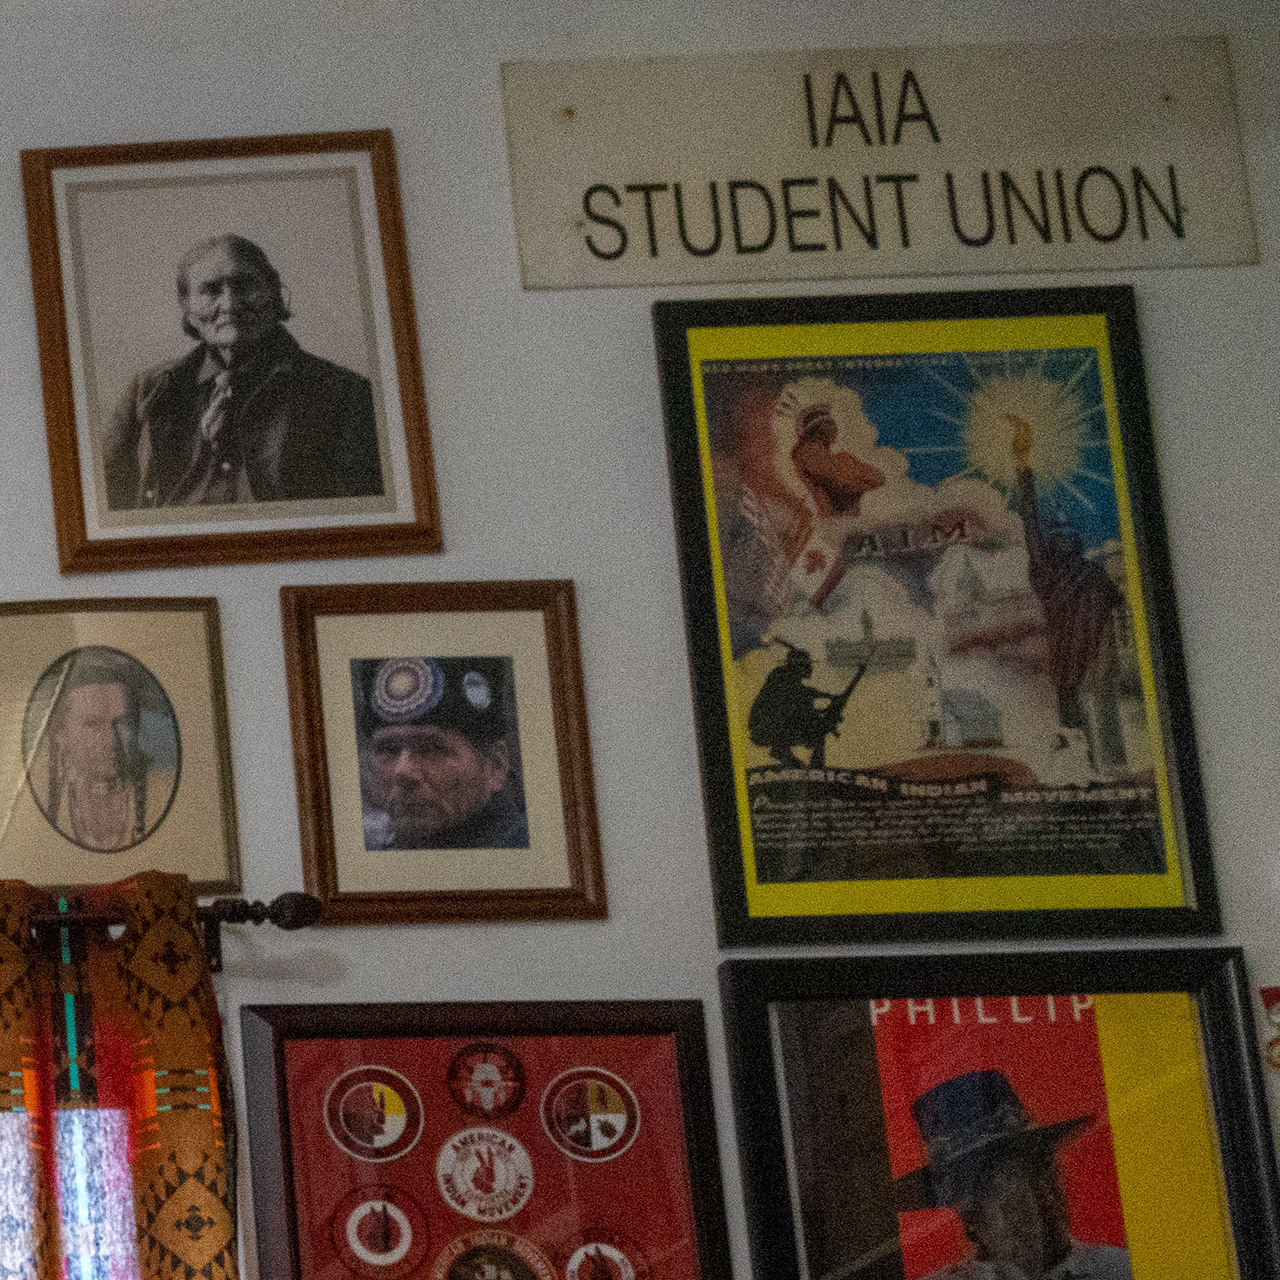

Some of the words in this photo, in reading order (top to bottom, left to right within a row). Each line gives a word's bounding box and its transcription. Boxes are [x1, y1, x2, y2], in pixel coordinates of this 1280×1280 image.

[802, 70, 942, 148] IAIA
[581, 173, 919, 261] STUDENT
[944, 165, 1187, 247] UNION
[748, 768, 889, 794] AMERICAN
[898, 779, 989, 797] INDIAN
[1000, 787, 1154, 805] MOVEMENT
[869, 995, 1097, 1027] PHILLIP
